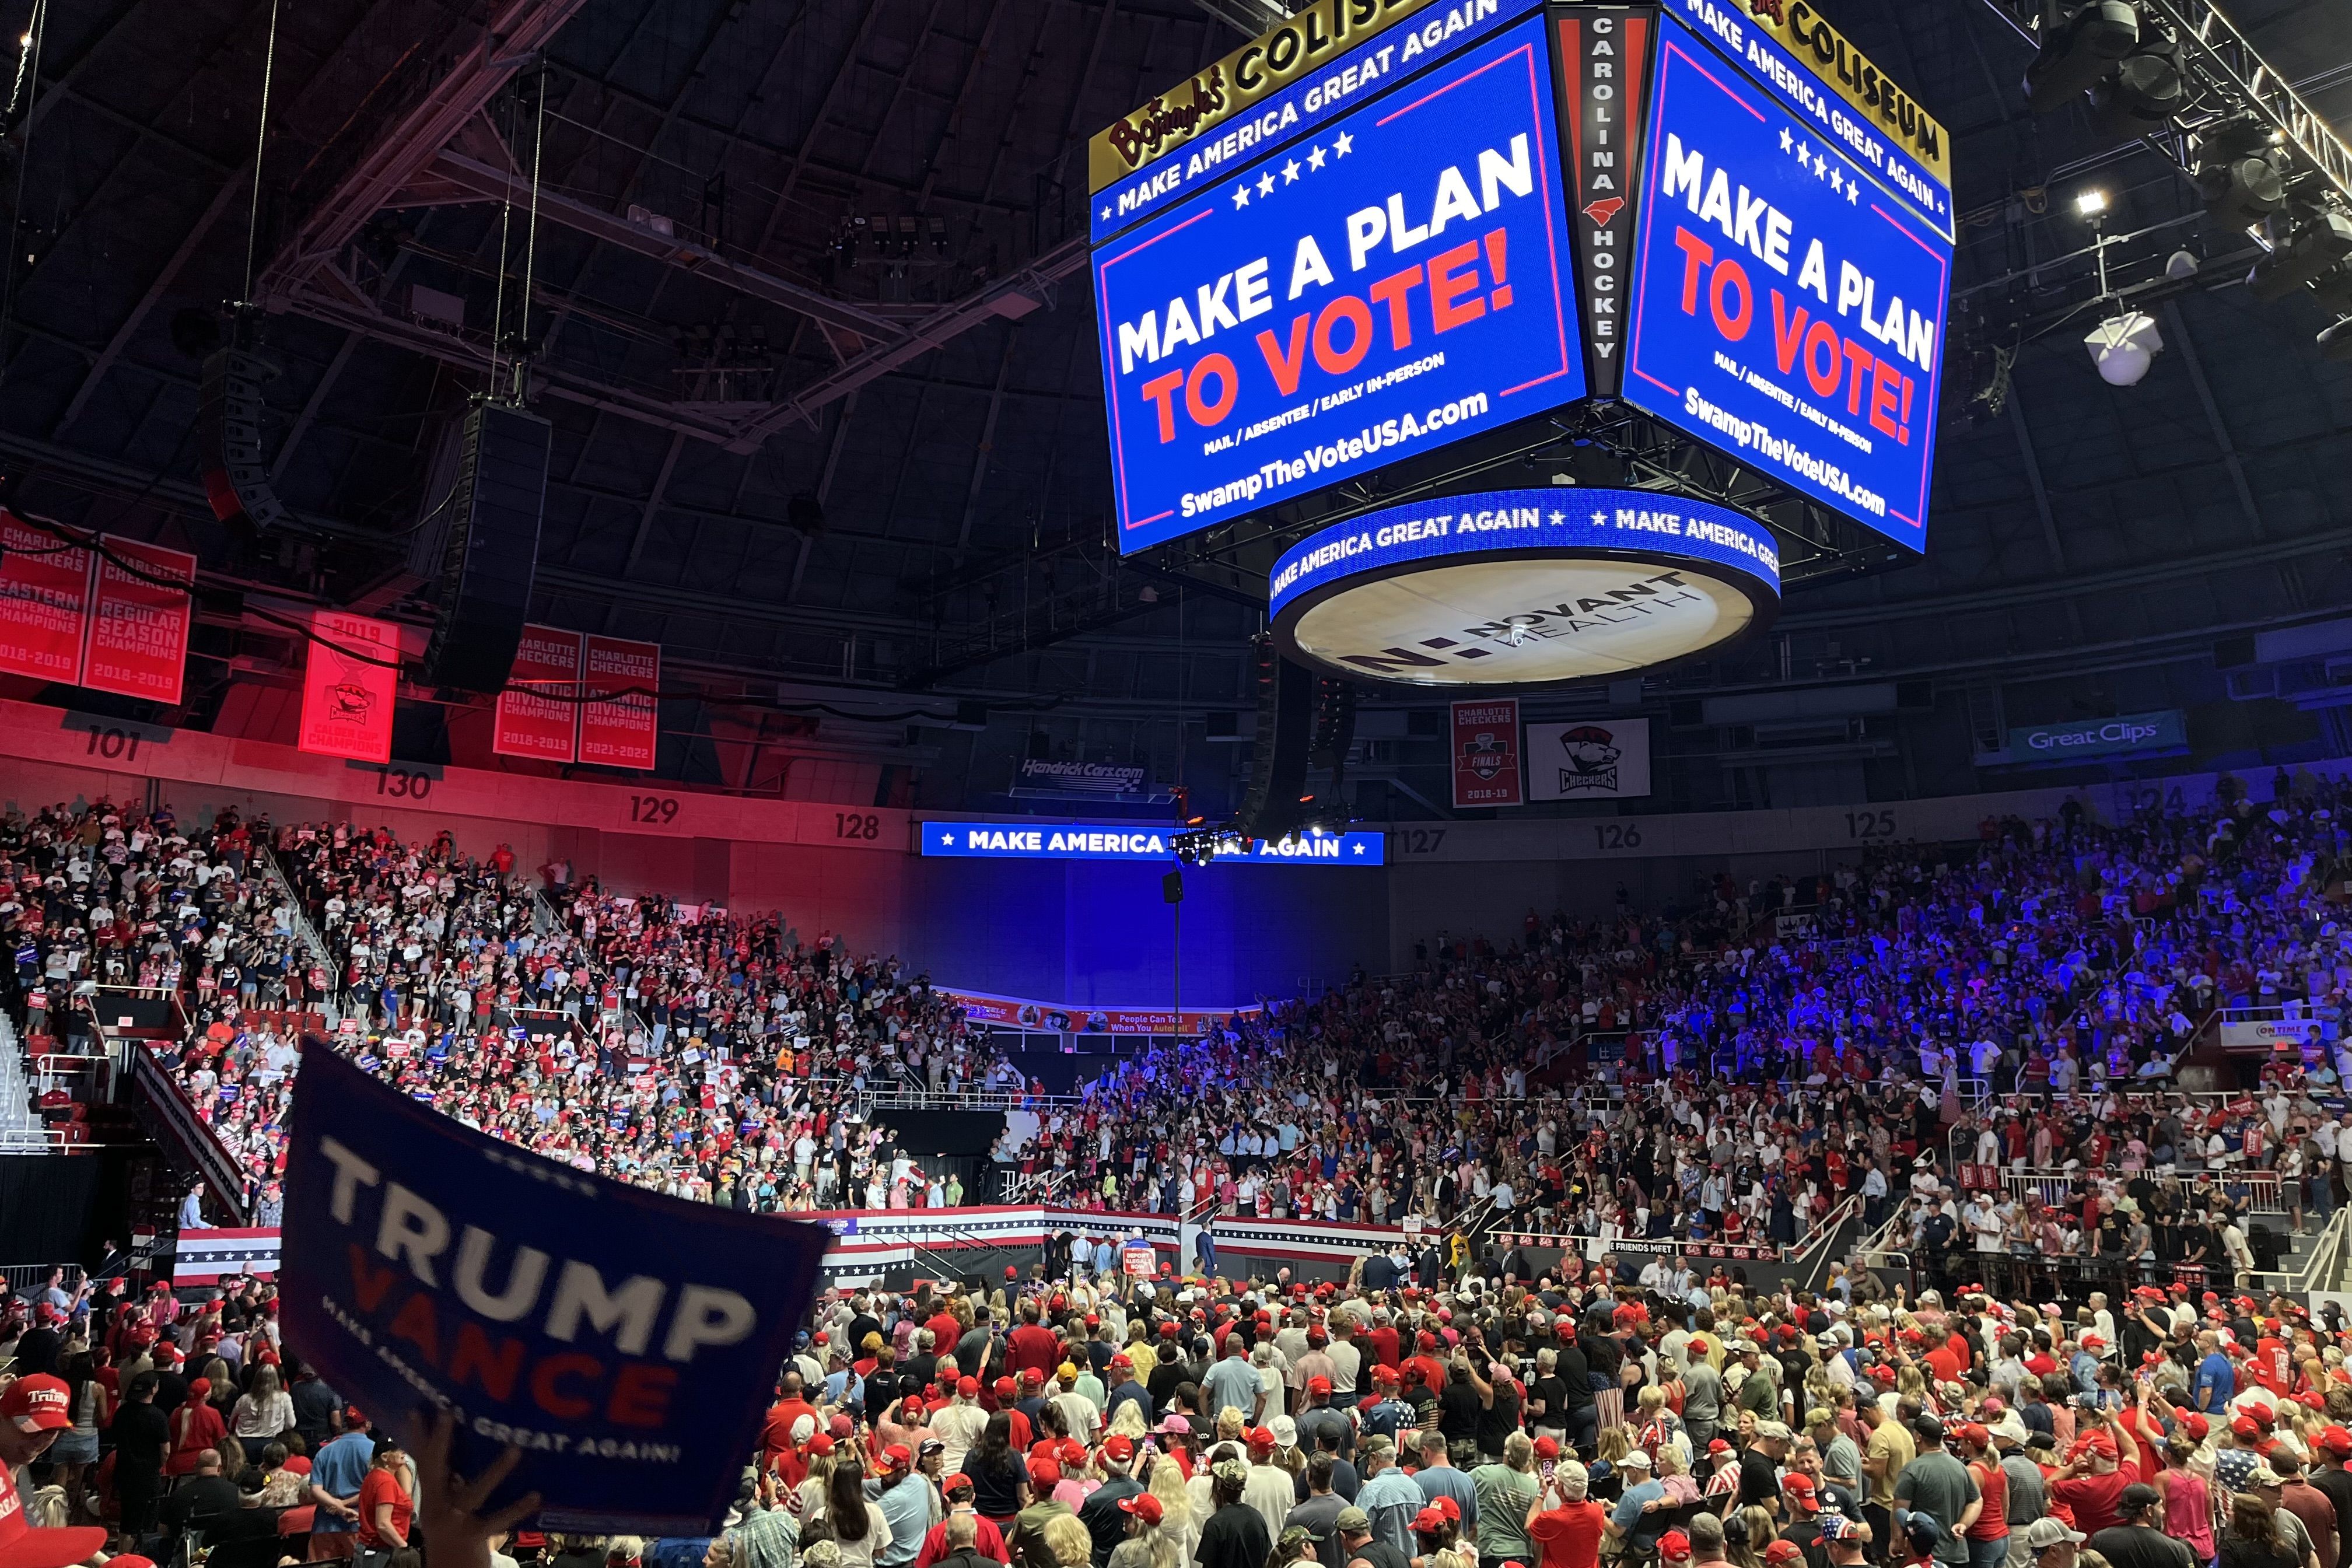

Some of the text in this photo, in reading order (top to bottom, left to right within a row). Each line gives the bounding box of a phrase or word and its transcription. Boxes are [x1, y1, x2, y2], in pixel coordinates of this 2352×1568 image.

[1787, 2, 1940, 162] COLISEUM
[1118, 0, 1497, 216] MAKE AMERICA GREAT AGAIN
[1592, 18, 1615, 191] CAROLINA
[1687, 0, 1744, 53] MAKE
[1746, 39, 1829, 125] AMERICA
[1831, 109, 1884, 167] GREAT
[1887, 156, 1934, 211] AGAIN
[1118, 132, 1534, 374] MAKE A PLAN
[1663, 132, 1934, 372] MAKE A PLAN
[1594, 230, 1615, 359] HOCKEY
[1142, 228, 1513, 444] TO VOTE!
[1674, 225, 1915, 446] TO VOTE!
[1203, 433, 1234, 456] MAIL
[1244, 404, 1311, 442] ABSENTEE
[1321, 383, 1364, 412] EARLY
[1366, 352, 1445, 401] IN-PERSON
[1714, 351, 1740, 378] MAIL
[1746, 370, 1794, 408] ABSENTEE
[1800, 402, 1828, 429] EARLY
[1828, 418, 1873, 454] IN-PERSON
[1181, 392, 1489, 518] SwampTheVoteUSA.com
[1685, 387, 1886, 517] SwampTheVoteUSA.com
[1615, 509, 1681, 534] MAKE
[1685, 518, 1757, 558] AMERICA
[1275, 508, 1539, 594] MAKE AMERICA GREAT AGAIN
[0, 597, 78, 621] ONFERENCE
[101, 601, 180, 632] REGULAR
[1463, 570, 1688, 638] NOVANT
[0, 606, 76, 634] HAMPIONS
[332, 619, 380, 642] 2019
[1493, 591, 1702, 647] HEALTH
[99, 617, 178, 648] SEASON
[0, 644, 71, 670] 018-2019
[97, 634, 177, 660] CHAMPIONS
[517, 649, 575, 668] HECKERS
[518, 639, 576, 656] HARLOTTE
[590, 649, 654, 667] CHARLOTTE
[94, 663, 173, 689] 2018-2019
[590, 660, 654, 678] CHECKERS
[506, 691, 571, 711] DIVISION
[589, 689, 651, 706] ATANTIC
[505, 704, 570, 722] CHAMPIONS
[586, 715, 650, 732] CHAMPIONS
[587, 702, 651, 721] DIVISION
[1458, 707, 1511, 718] CHARLOTTE
[1458, 715, 1511, 725] CHECKERS
[87, 725, 140, 761] 101
[308, 733, 382, 754] CHAMPIONS
[358, 730, 379, 741] CUP
[503, 732, 568, 751] 2018-2019
[2028, 722, 2157, 749] Great Clips
[586, 742, 649, 758] 2021-2022
[1472, 755, 1501, 768] FINALS
[377, 767, 430, 799] 130
[1467, 788, 1507, 800] 2018-19
[631, 796, 679, 824] 129
[835, 813, 879, 840] 128
[1595, 824, 1642, 849] 126
[1845, 811, 1896, 838] 125
[969, 831, 1042, 850] MAKE
[1048, 832, 1164, 854] AMERICA
[1260, 838, 1339, 857] AGAIN
[1401, 830, 1447, 853] 127
[1111, 1024, 1135, 1032] When
[1119, 1015, 1183, 1024] People Can Tel
[2277, 1026, 2302, 1034] TIME
[320, 1135, 757, 1364] TRUMP
[1519, 1236, 1533, 1244] Ed's
[1539, 1237, 1552, 1245] Ed's
[1559, 1238, 1573, 1247] Ed's
[1615, 1242, 1648, 1253] FRIENDS
[1651, 1245, 1672, 1254] MEET
[1685, 1245, 1700, 1254] Ed's
[1709, 1246, 1724, 1255] Ed's
[1732, 1247, 1748, 1257] Ed's
[347, 1243, 678, 1429] VANCE
[473, 1416, 571, 1452] GREAT
[576, 1437, 682, 1463] AGAIN!
